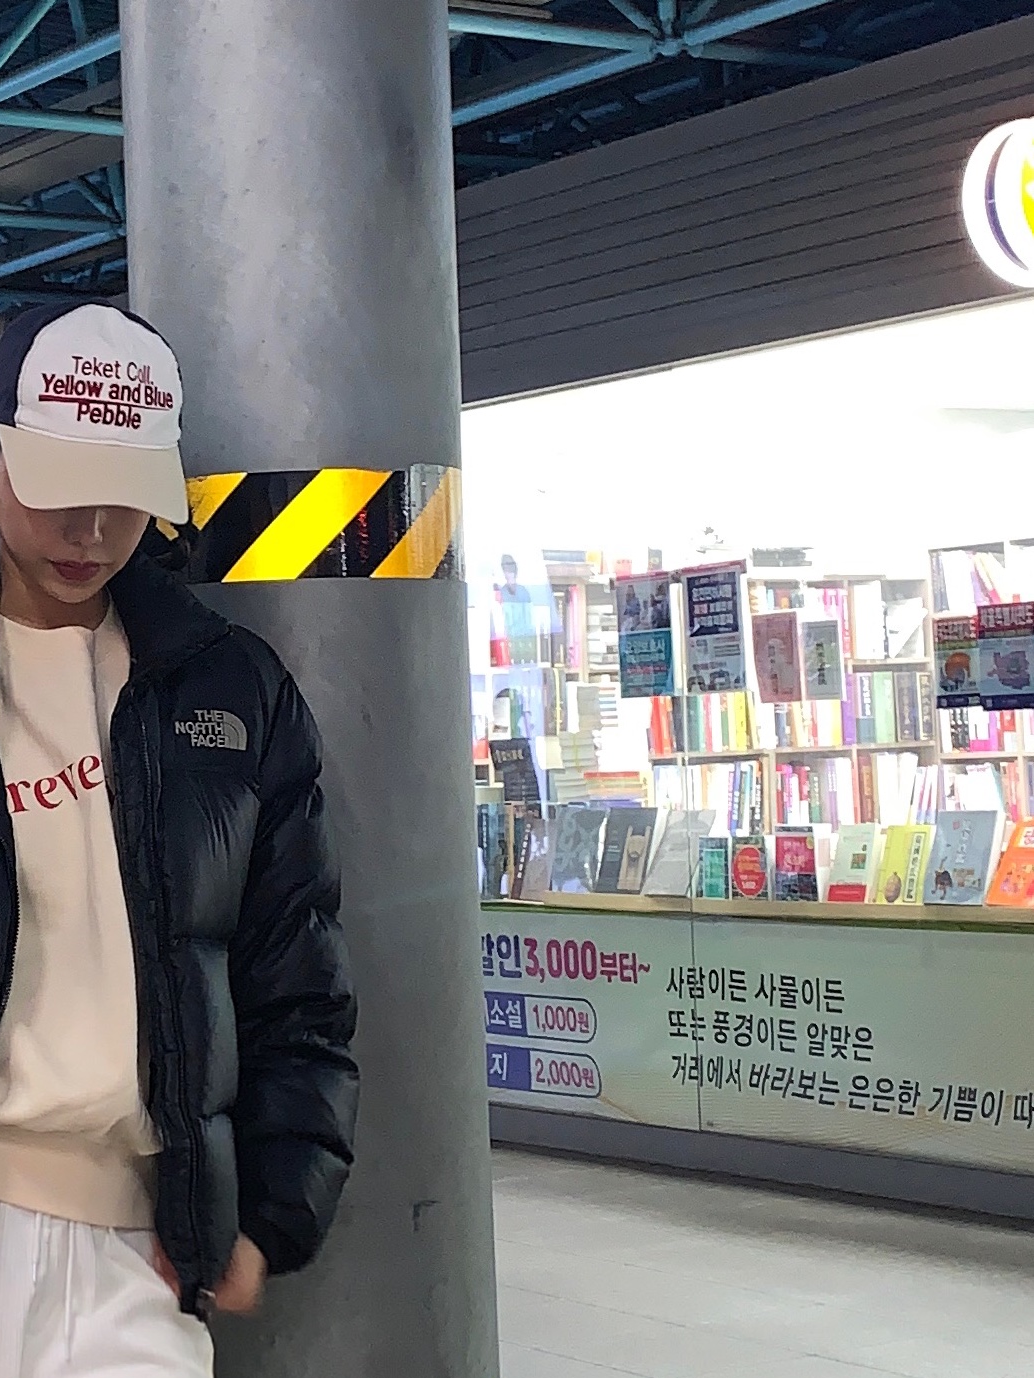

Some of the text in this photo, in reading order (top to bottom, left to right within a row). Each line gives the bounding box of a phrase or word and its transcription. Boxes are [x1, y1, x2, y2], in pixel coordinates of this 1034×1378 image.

[72, 355, 121, 379] Teket
[41, 373, 174, 410] Yellow and Blue
[76, 402, 142, 430] Pebble
[174, 721, 224, 735] NORTH
[194, 709, 225, 722] THE
[191, 734, 227, 748] FACE
[666, 966, 845, 1014] 사람이든 사물이든
[532, 1004, 590, 1034] 1,000원
[668, 1008, 874, 1063] 또는 풍경이든 알맞은
[534, 1058, 596, 1090] 2,000원
[671, 1053, 742, 1093] 거리에서
[748, 1063, 840, 1107] 바라보는
[848, 1074, 921, 1116] 은은한
[927, 1084, 1005, 1127] 기쁨이
